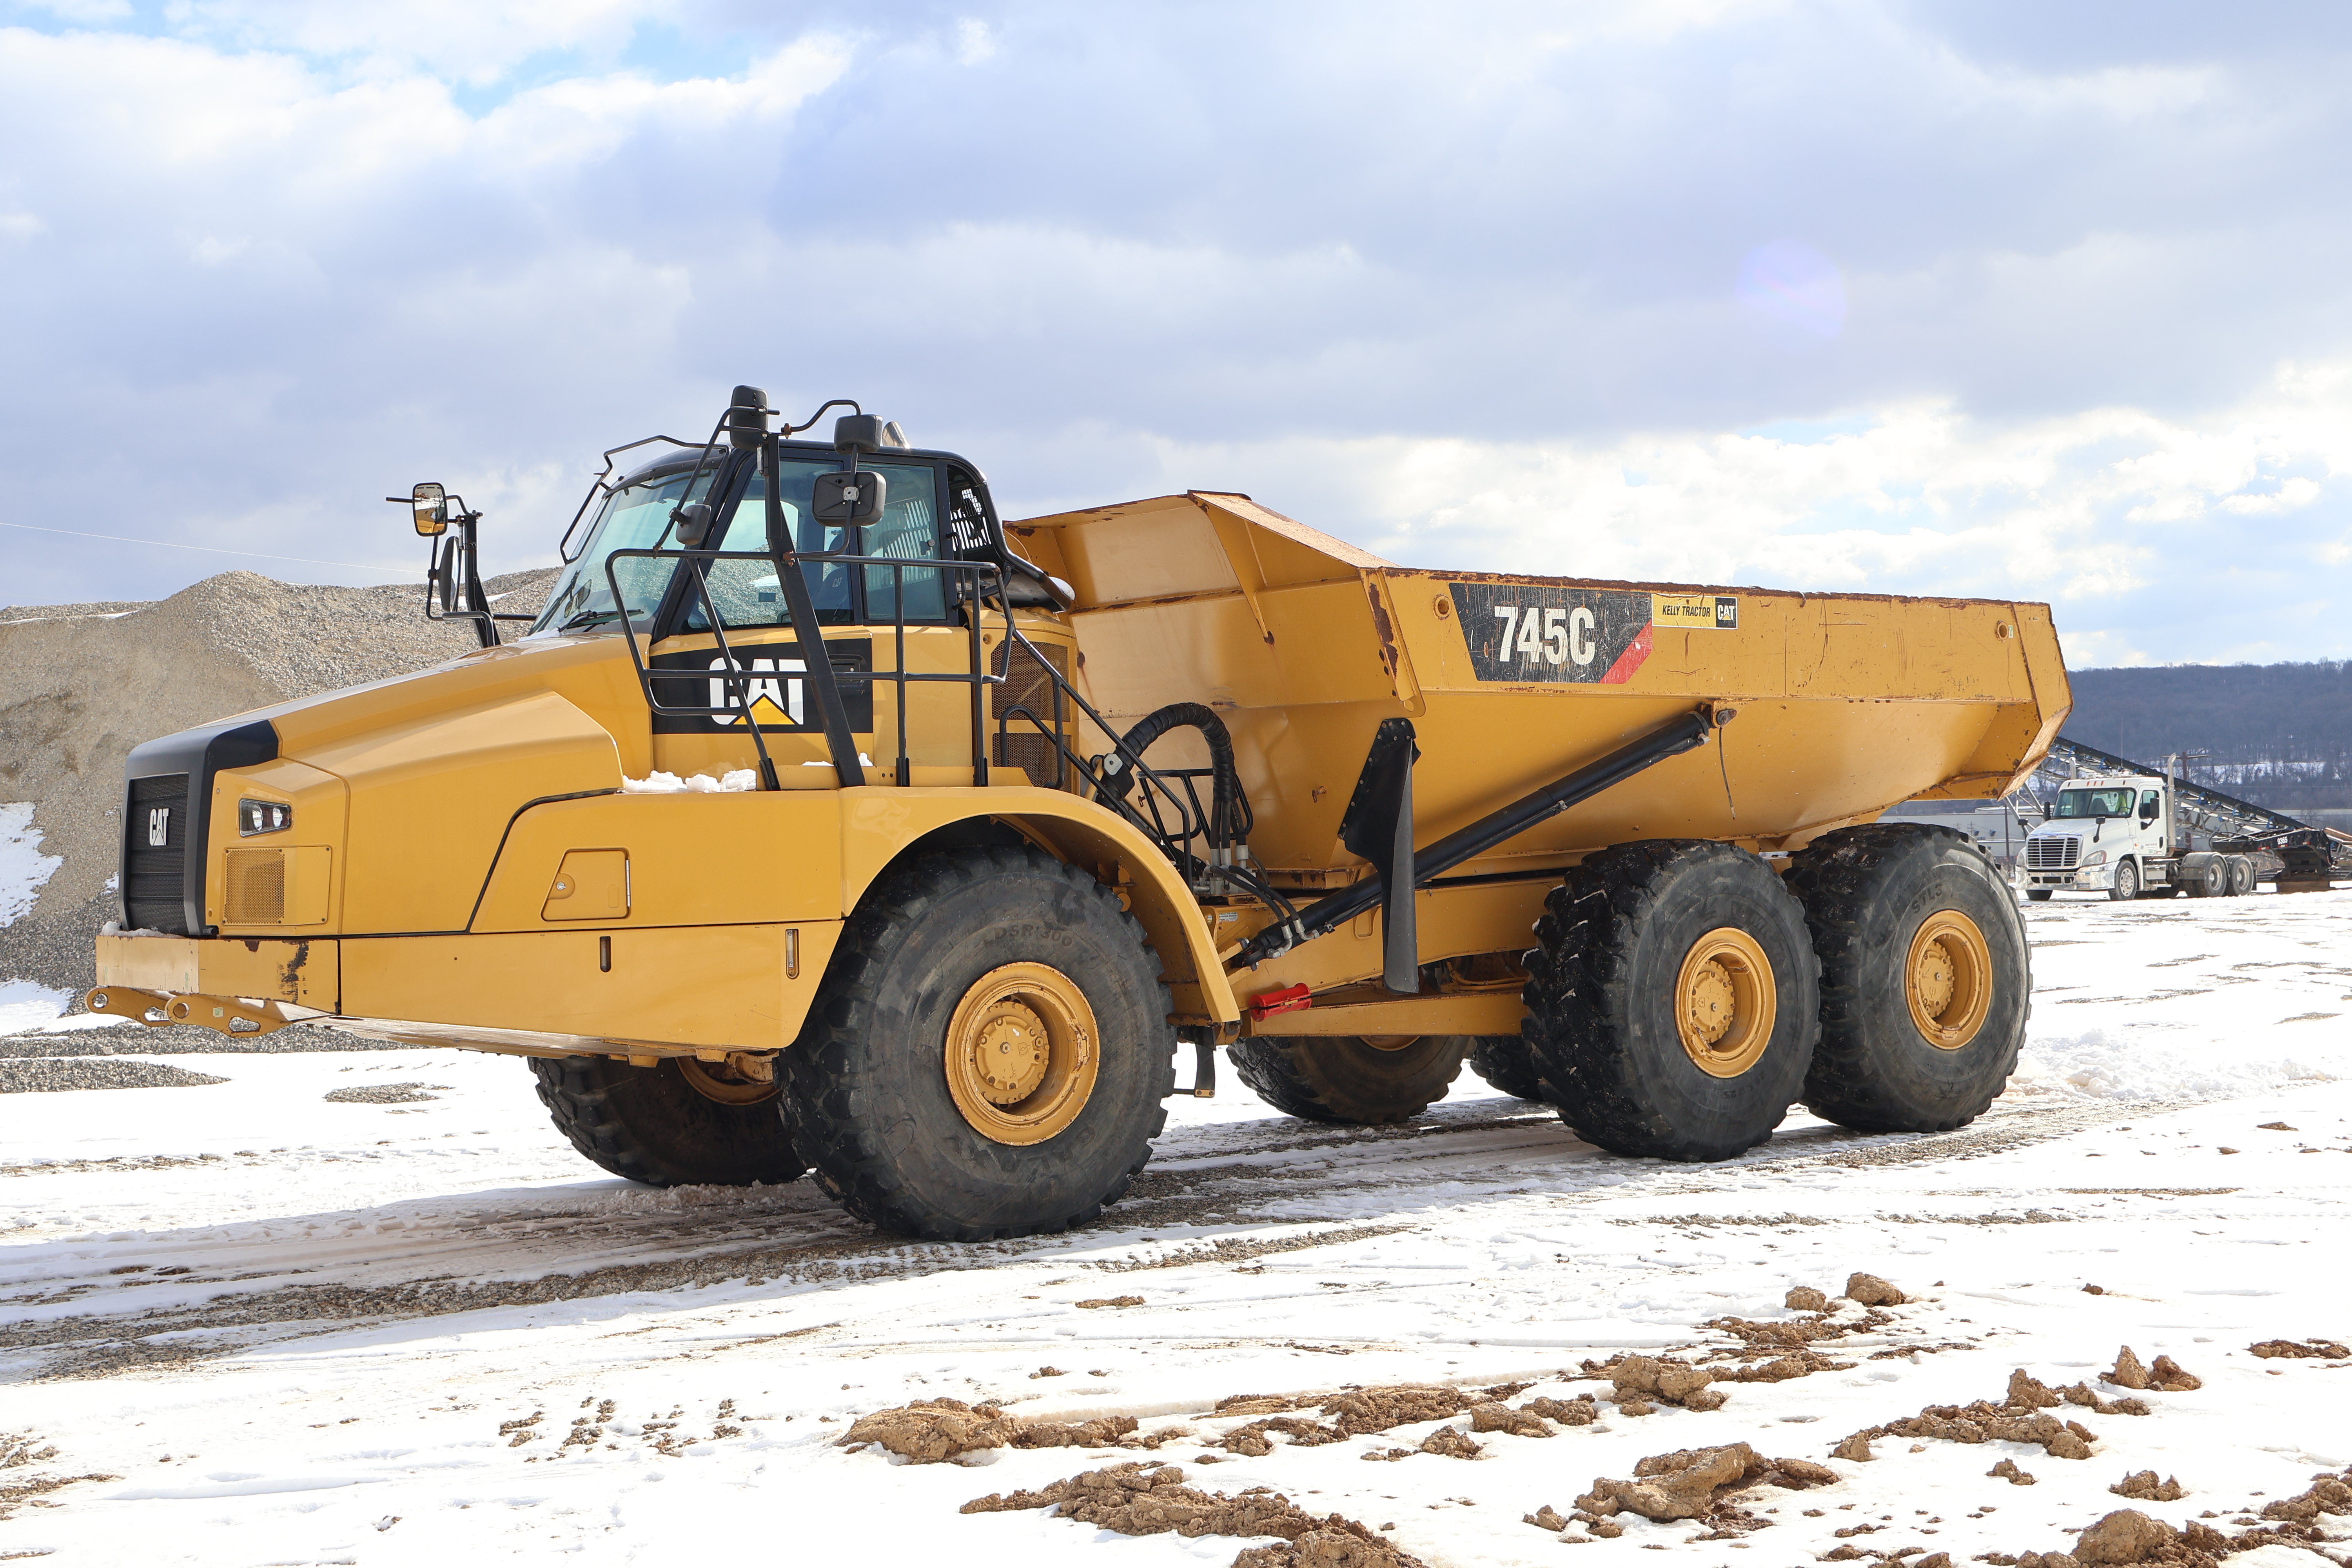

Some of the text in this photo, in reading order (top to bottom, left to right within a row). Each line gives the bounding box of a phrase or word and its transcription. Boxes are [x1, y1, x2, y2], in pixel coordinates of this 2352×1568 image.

[832, 577, 843, 588] CAT
[1662, 605, 1711, 617] KELLY TRACTOR
[1717, 604, 1735, 621] CAT
[1494, 606, 1595, 665] 745C
[709, 657, 808, 725] CAT
[150, 808, 169, 846] CAT
[2277, 836, 2288, 845] 9365
